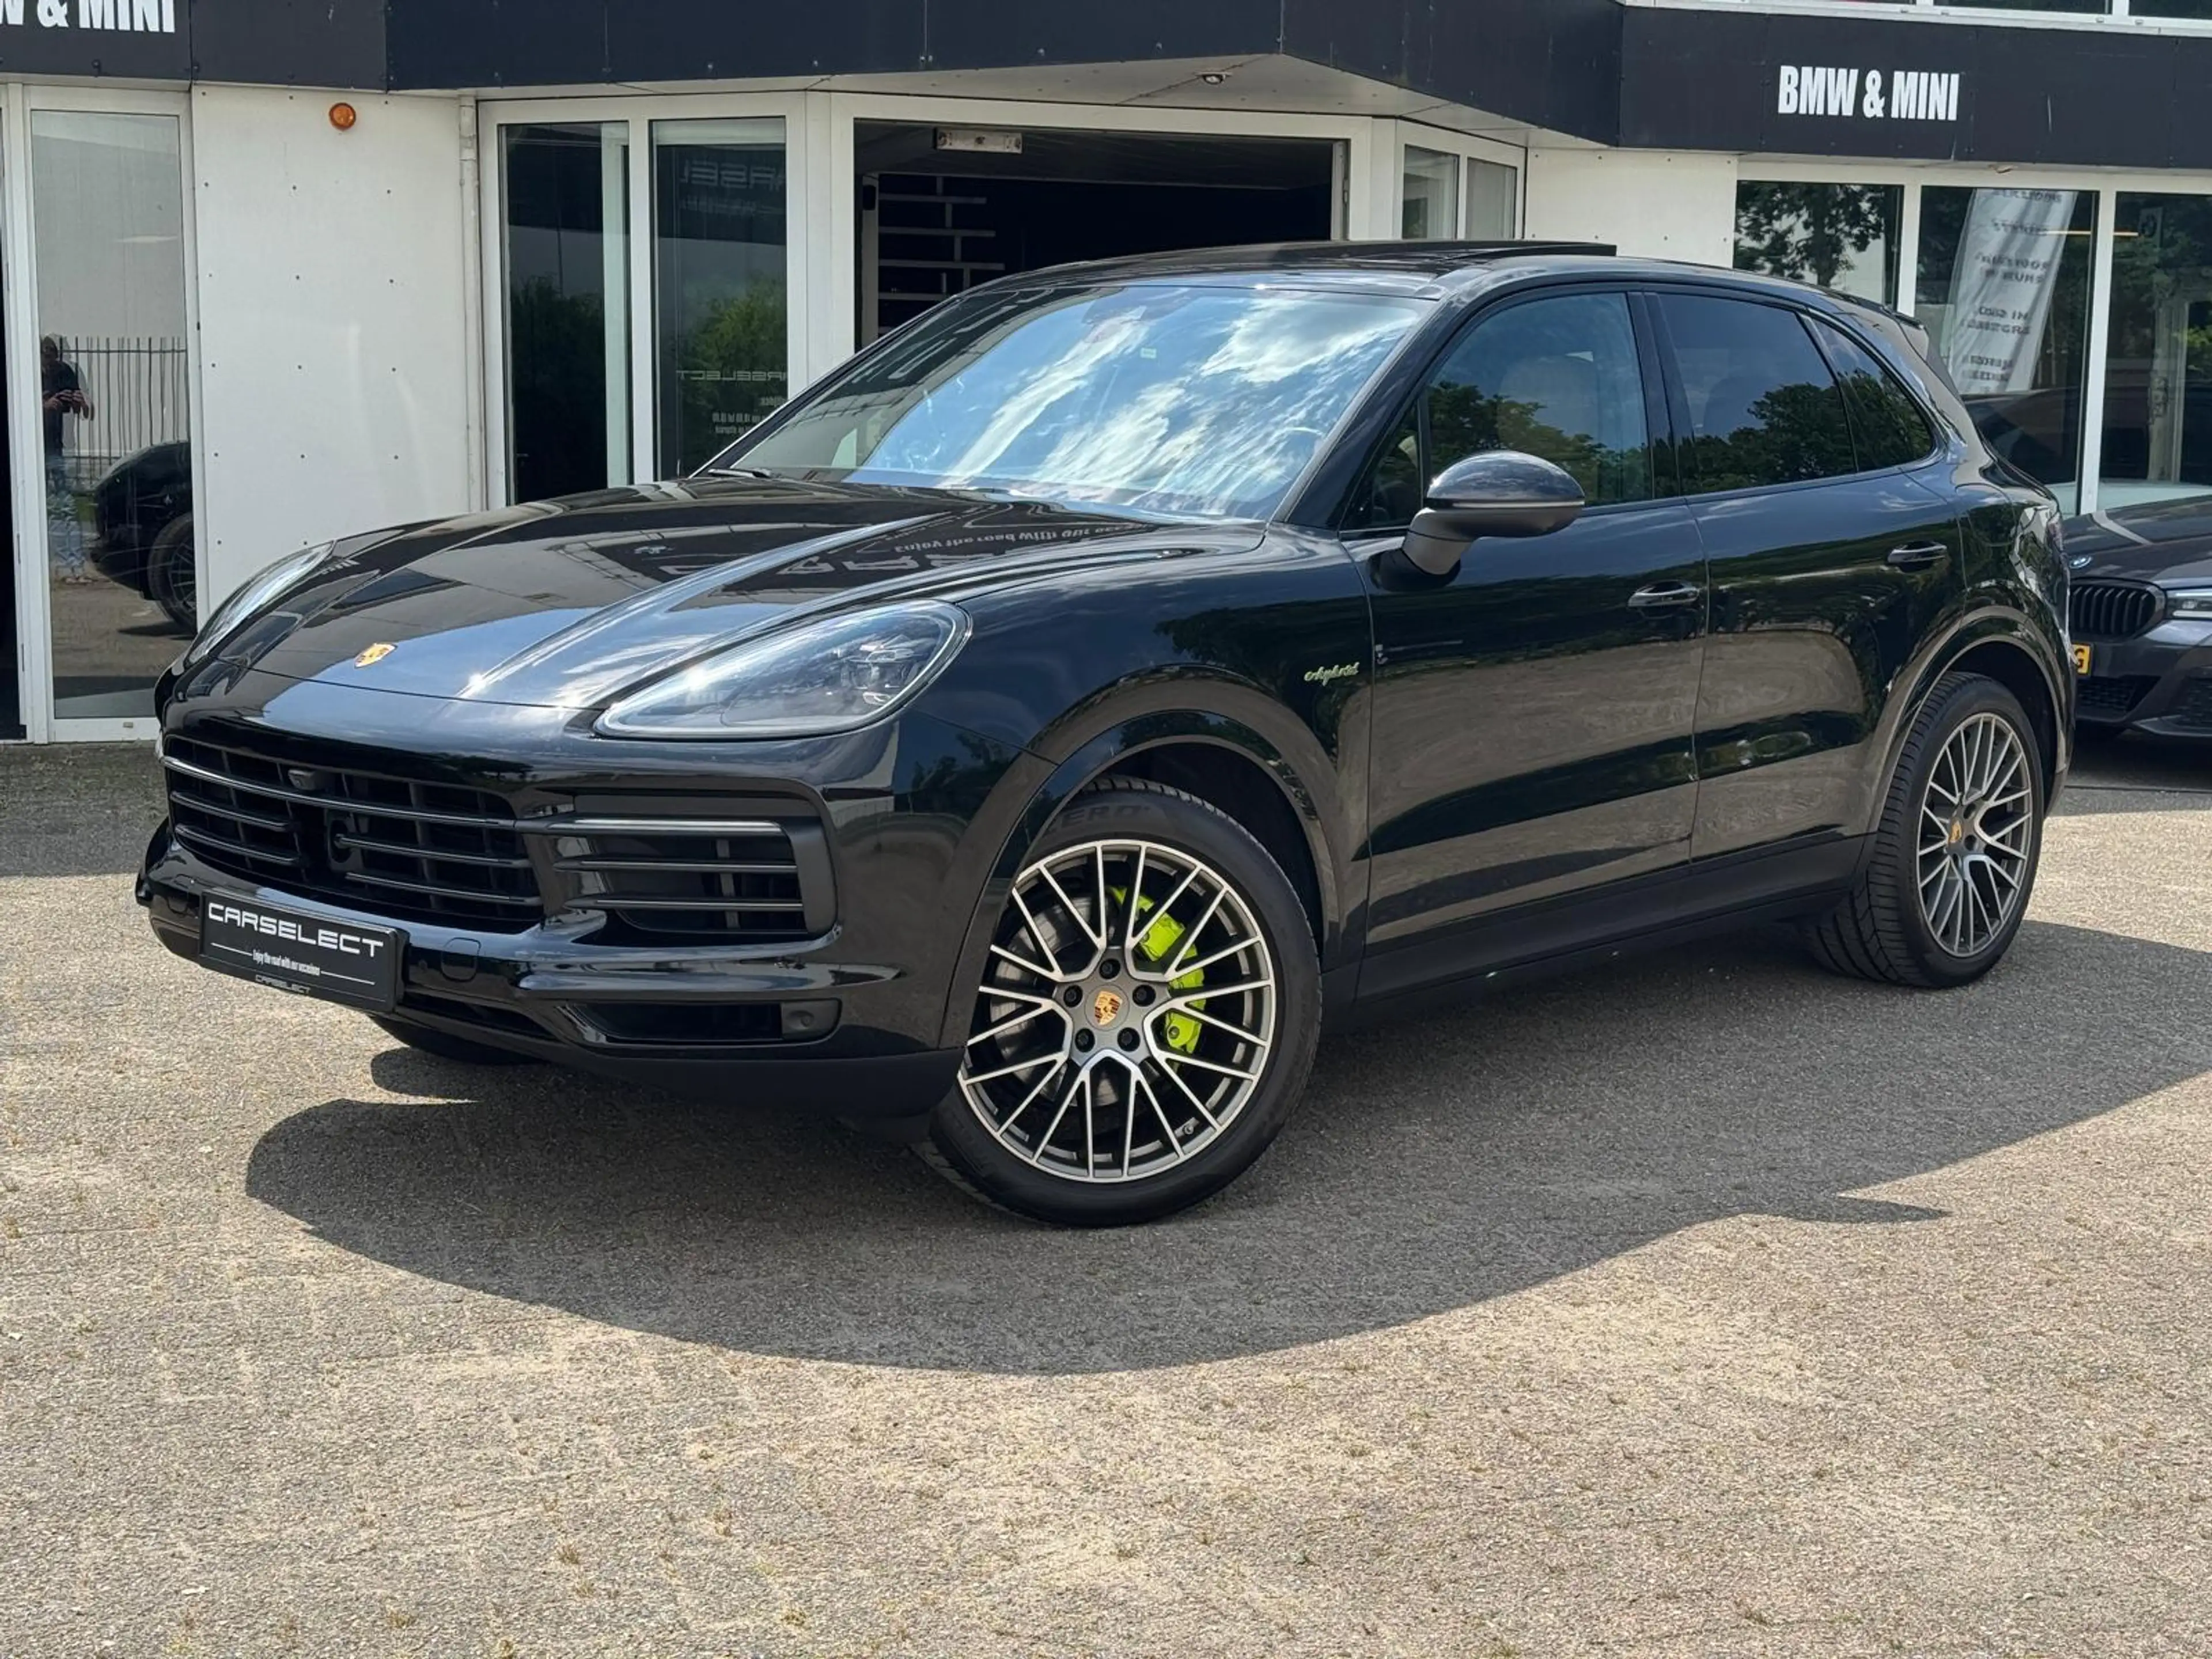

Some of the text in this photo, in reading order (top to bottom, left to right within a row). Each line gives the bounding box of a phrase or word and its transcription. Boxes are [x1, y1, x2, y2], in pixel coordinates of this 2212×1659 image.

[1778, 65, 1959, 121] BMW & MINI
[208, 902, 384, 957] CARSELECT
